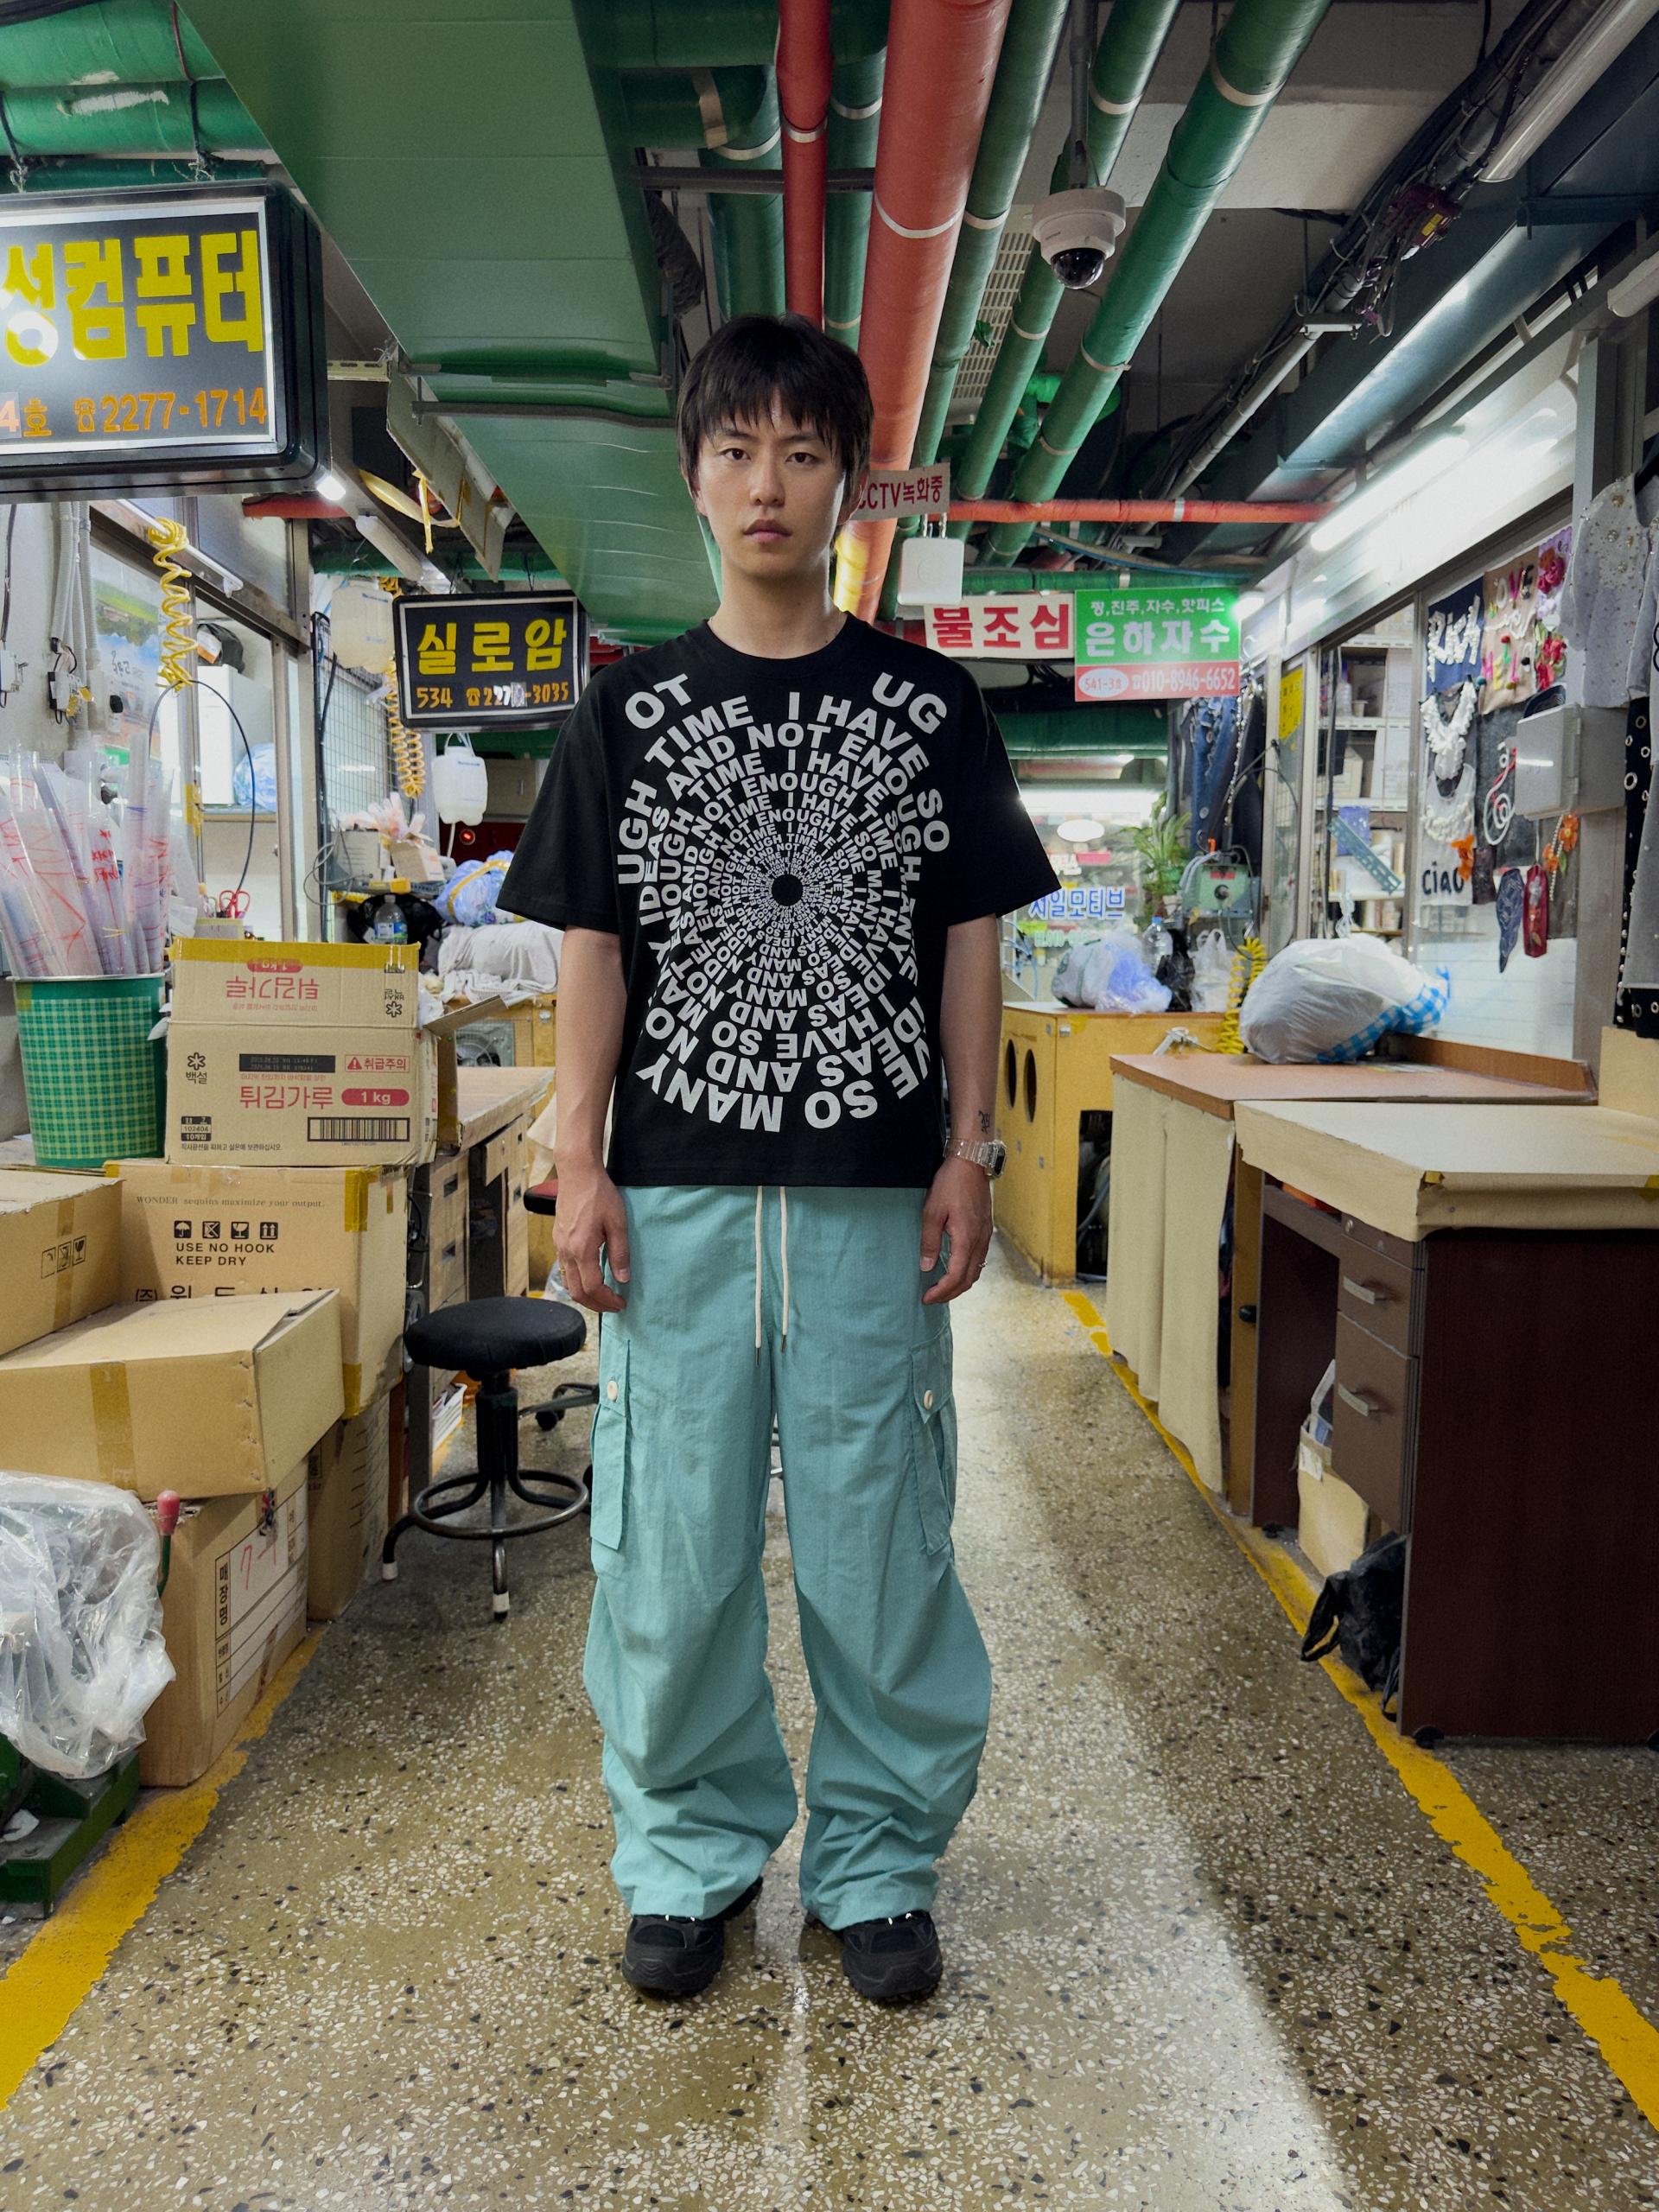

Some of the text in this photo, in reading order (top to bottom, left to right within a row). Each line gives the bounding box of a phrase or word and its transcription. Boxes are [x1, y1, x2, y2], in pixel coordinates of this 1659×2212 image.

[102, 388, 267, 433] 2277-1714
[858, 475, 943, 510] CTV녹화중
[932, 605, 1070, 650] 불조심
[1085, 619, 1230, 658] 은하자수
[416, 618, 567, 676] 실로암
[416, 687, 453, 709] 534
[788, 749, 796, 770] I
[688, 753, 765, 803] TIME
[741, 772, 857, 808] ENOUGH
[807, 751, 889, 807] HAVE
[691, 787, 734, 839] NOT
[756, 809, 836, 833] ENOUGH
[721, 819, 750, 855] NOT
[740, 823, 777, 848] TIME
[786, 834, 818, 849] TIME
[788, 823, 791, 832] I
[798, 823, 836, 849] HAVE
[859, 803, 898, 869] TIME
[734, 835, 782, 874] ENOUGH
[753, 846, 774, 865] AND
[759, 851, 782, 868] TIME
[776, 842, 800, 852] NOT
[792, 851, 817, 868] HAVE
[820, 849, 829, 857] I
[834, 849, 849, 869] SO
[836, 829, 865, 874] TIME
[683, 846, 698, 902] AND
[791, 857, 803, 866] SO
[801, 845, 833, 885] ENOUGH
[802, 862, 819, 882] MANY
[814, 866, 823, 880] SO
[825, 856, 842, 892] HAVE
[618, 692, 949, 1092] I HAVE SO IDEAS AND NO UGH TIME
[639, 722, 921, 1058] NOT ENOUGH I HAVE SO MANY IDEAS AND
[660, 807, 694, 951] ENOUGH
[691, 792, 882, 988] I HAVE SO MANY IDEAS AND NOT ENOUGH TIME
[709, 859, 724, 899] AND
[721, 849, 742, 918] ENOUGH
[732, 876, 741, 904] NOT
[740, 864, 754, 898] IDEAS
[747, 866, 762, 906] ENOUGH
[753, 872, 766, 892] TIME
[754, 893, 778, 921] ENOUGH
[815, 880, 826, 911] MANY
[818, 887, 834, 916] TIME
[829, 896, 841, 913] SO
[836, 874, 853, 923] MANY
[736, 908, 756, 931] AND
[741, 901, 766, 930] MANY
[753, 907, 771, 925] NOT
[771, 920, 791, 931] AND
[792, 909, 818, 930] IDEAS
[796, 907, 811, 921] AND
[831, 899, 865, 948] HAVE
[710, 905, 745, 955] IDEAS
[729, 922, 757, 948] NOT
[756, 931, 794, 947] IDEAS
[766, 925, 781, 938] SO
[783, 922, 814, 938] HAVE
[798, 924, 839, 957] IDEAS
[800, 916, 832, 945] MANY
[851, 906, 897, 975] HAVE
[680, 912, 728, 985] IDEAS
[745, 951, 801, 971] MANY
[760, 944, 792, 958] AND
[808, 946, 831, 966] SO
[226, 976, 320, 1000] 튀김가루
[671, 958, 724, 1011] NOT
[727, 979, 807, 1007] MANY
[808, 962, 892, 1027] IDEAS
[817, 971, 851, 1000] SO
[729, 1001, 798, 1031] AND
[186, 1071, 207, 1084] 백설
[364, 1057, 407, 1071] 취급주의
[240, 1085, 334, 1110] 튀김가루
[360, 1091, 391, 1106] 1 kg
[636, 1053, 783, 1132] MANY
[805, 1080, 877, 1128] SO
[137, 1196, 179, 1205] WONDER
[183, 1198, 218, 1207] sequins
[221, 1198, 266, 1206] maximize
[269, 1199, 289, 1208] your
[175, 1255, 247, 1266] KEEP DRY
[176, 1243, 275, 1253] USE NO HOOK
